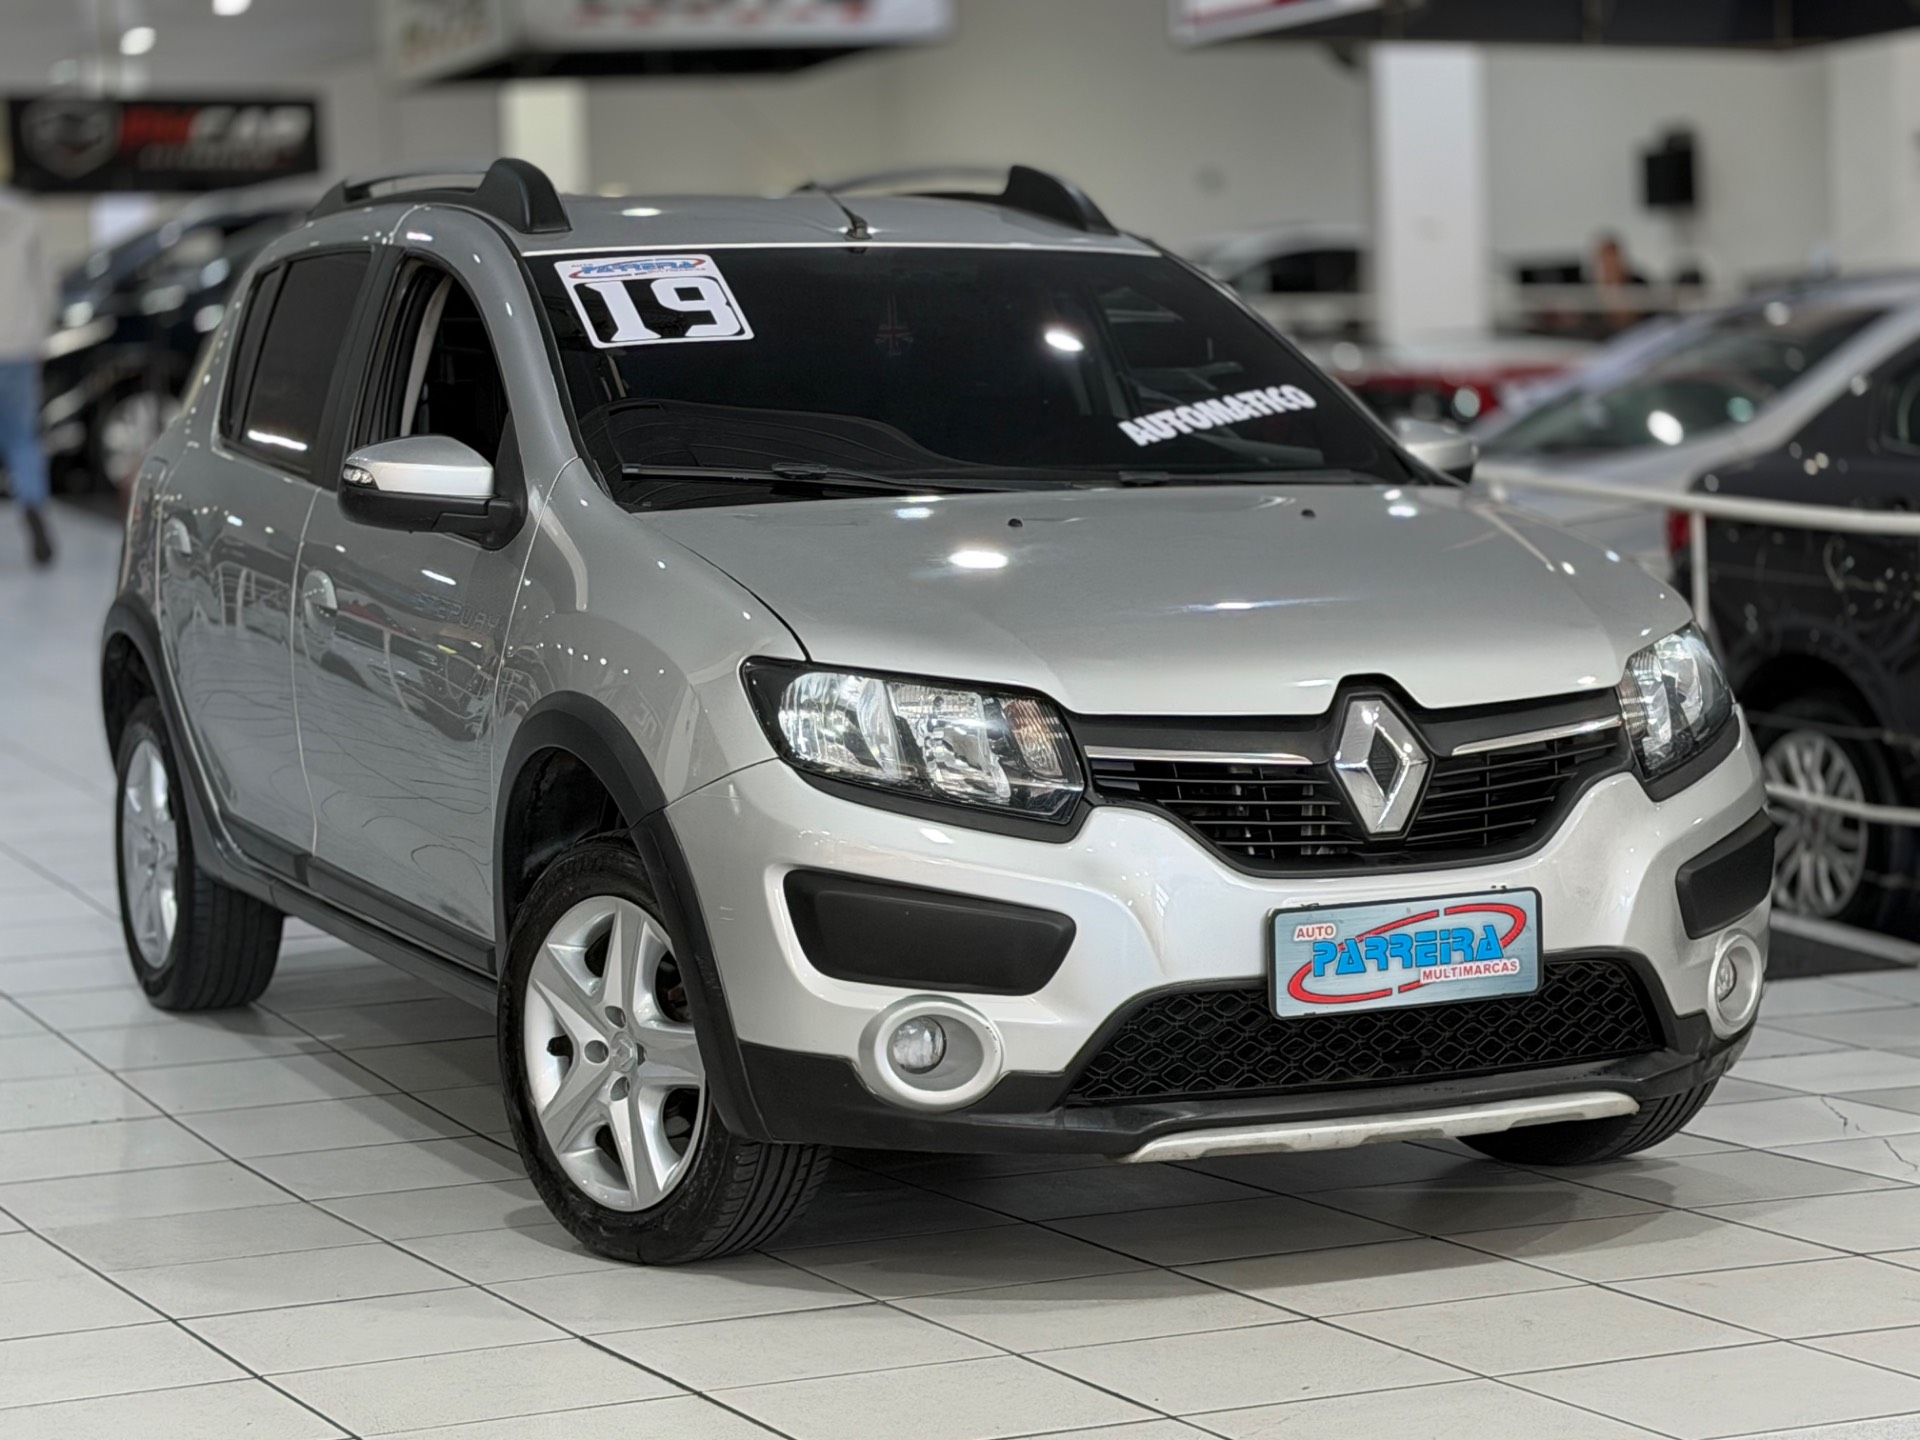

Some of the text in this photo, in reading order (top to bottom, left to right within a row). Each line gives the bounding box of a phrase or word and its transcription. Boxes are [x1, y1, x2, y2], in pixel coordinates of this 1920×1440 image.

[584, 276, 741, 341] 19
[1117, 384, 1317, 447] AUTOMATICO
[1296, 925, 1335, 940] AUTO
[1312, 924, 1505, 978] PARREIRA
[1421, 960, 1520, 982] MULTIMARCAS
